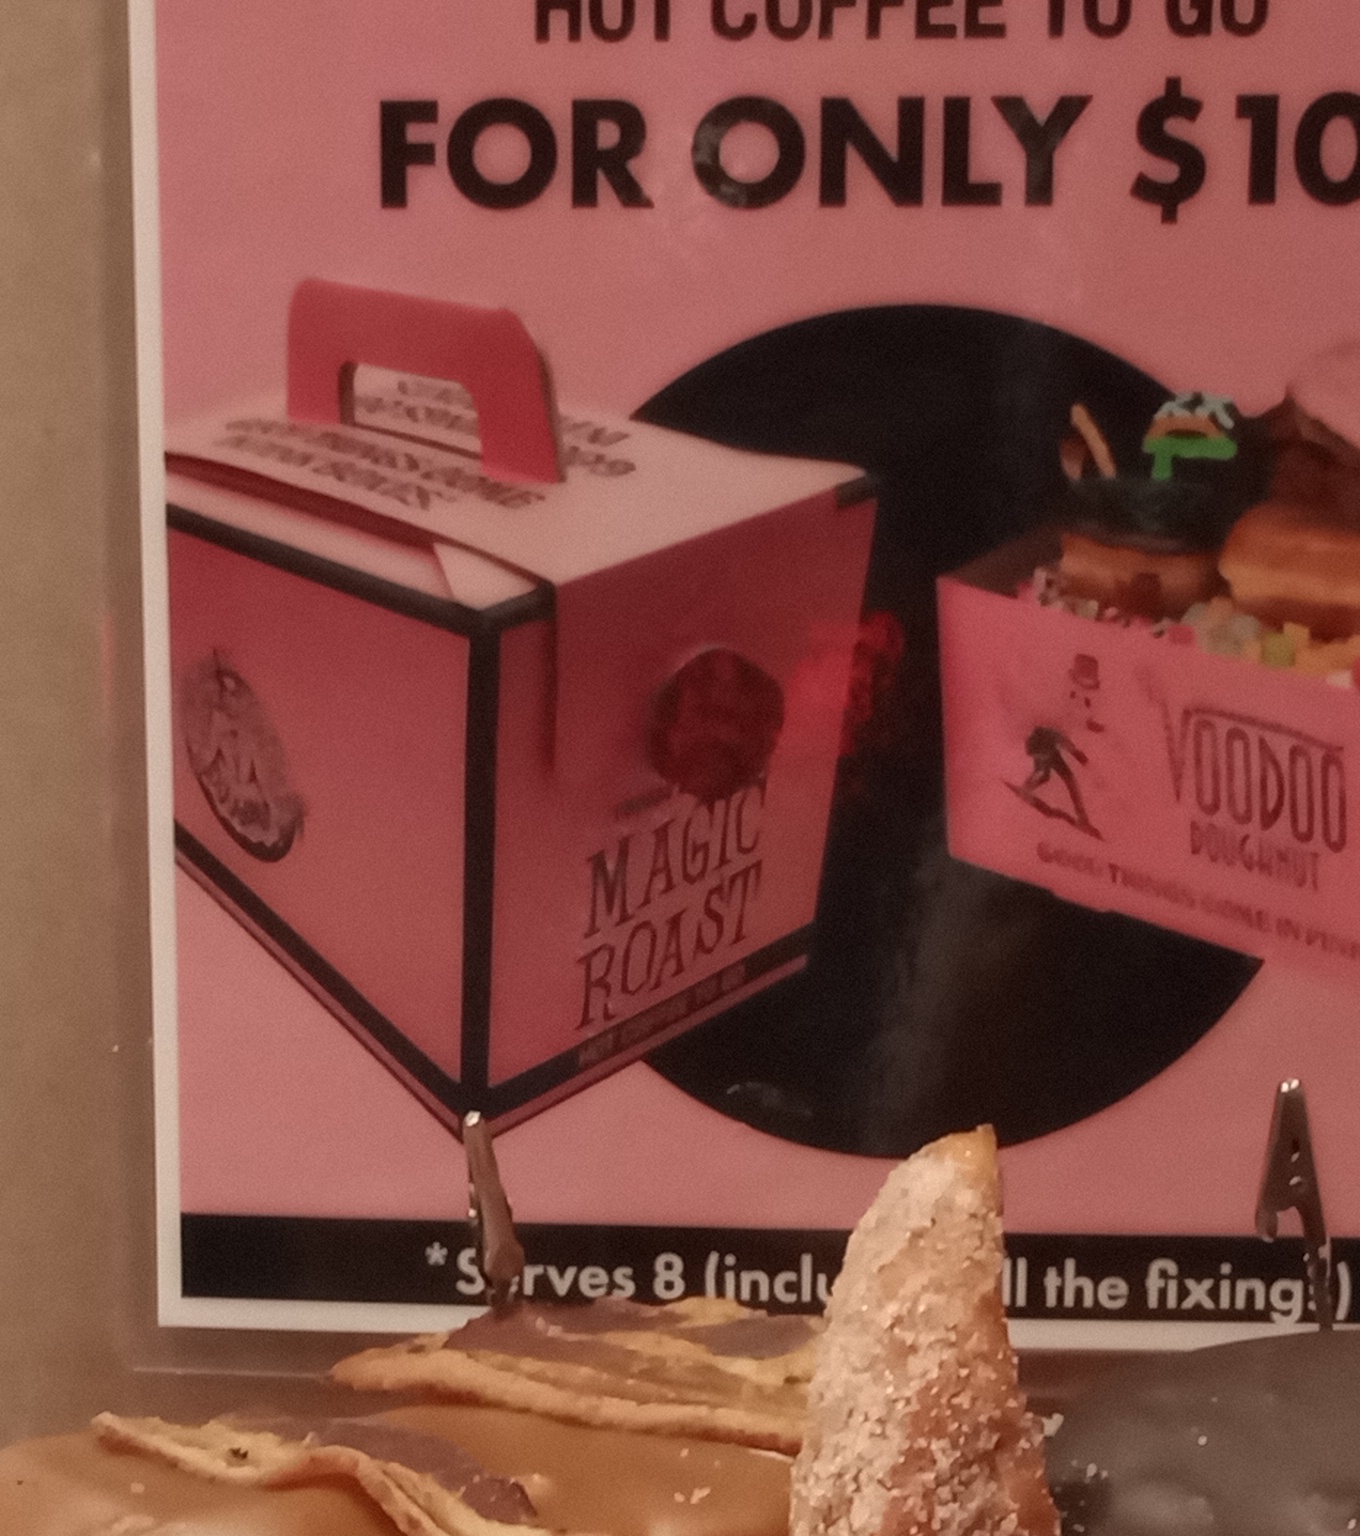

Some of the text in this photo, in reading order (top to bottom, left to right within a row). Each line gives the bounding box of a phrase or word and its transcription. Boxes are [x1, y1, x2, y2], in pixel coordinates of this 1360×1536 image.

[378, 96, 654, 211] FOR
[691, 94, 1093, 211] ONLY
[1137, 666, 1347, 854] VOODOO
[583, 774, 768, 940] MAGIC
[574, 859, 763, 1031] ROAST
[425, 1242, 636, 1298] Srves
[653, 1251, 686, 1300] 8
[1002, 1256, 1028, 1309] ll
[1043, 1257, 1129, 1310] the
[1145, 1257, 1352, 1324] fixing)
